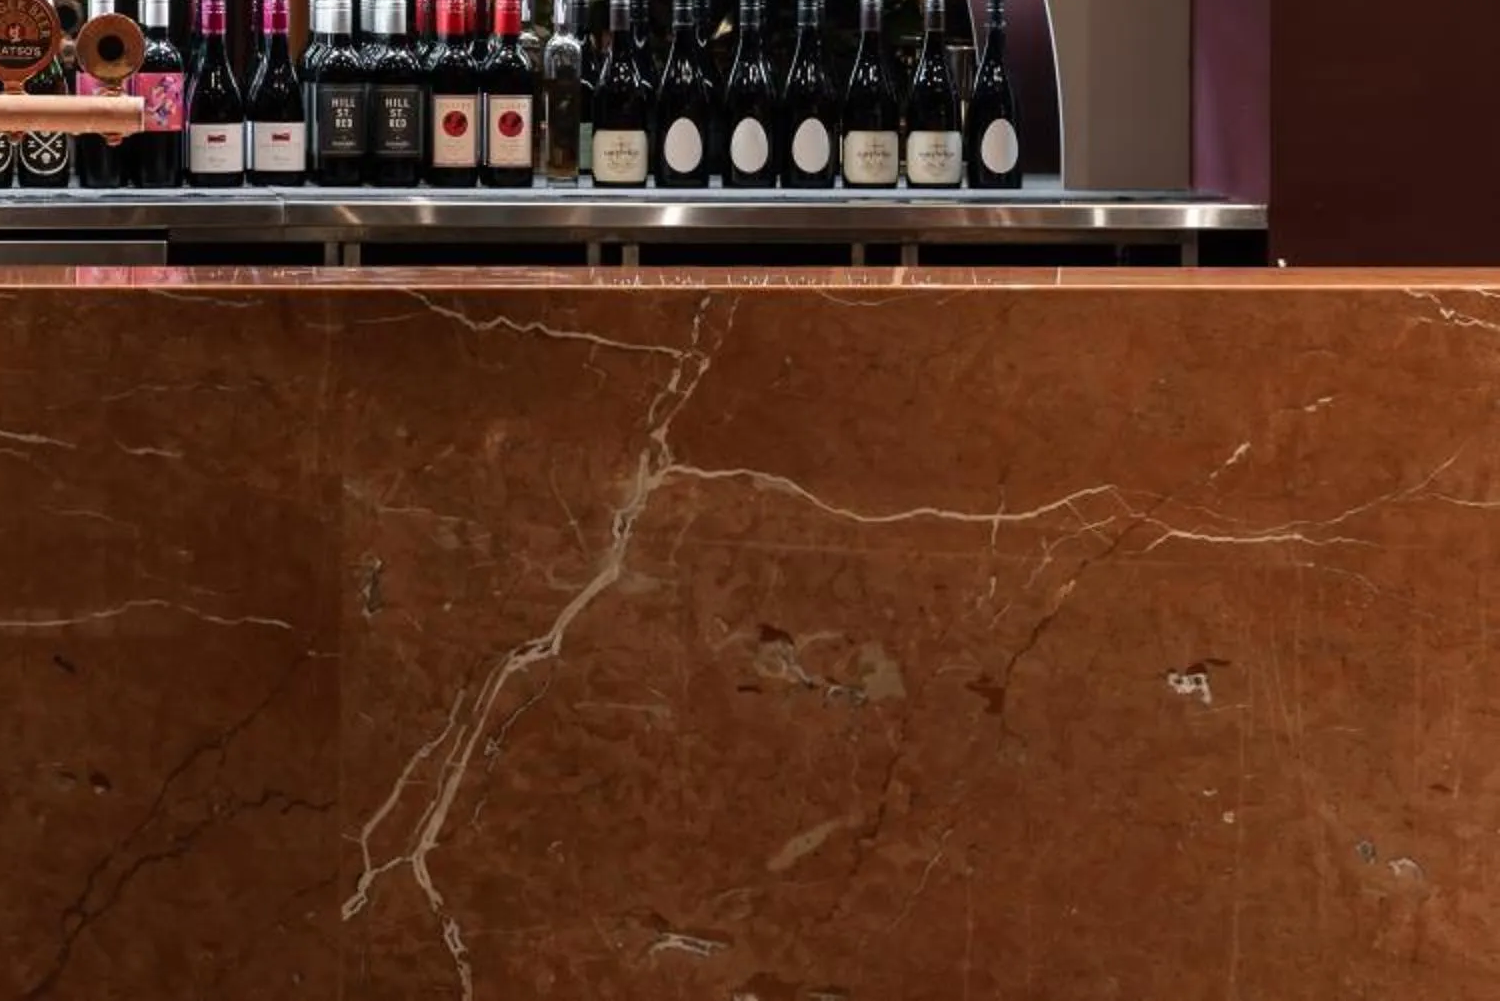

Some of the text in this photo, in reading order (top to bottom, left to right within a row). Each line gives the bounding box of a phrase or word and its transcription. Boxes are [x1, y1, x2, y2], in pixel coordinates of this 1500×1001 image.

[331, 97, 356, 108] HILL
[385, 97, 410, 108] HILL
[335, 118, 353, 128] RED
[389, 118, 407, 128] RED
